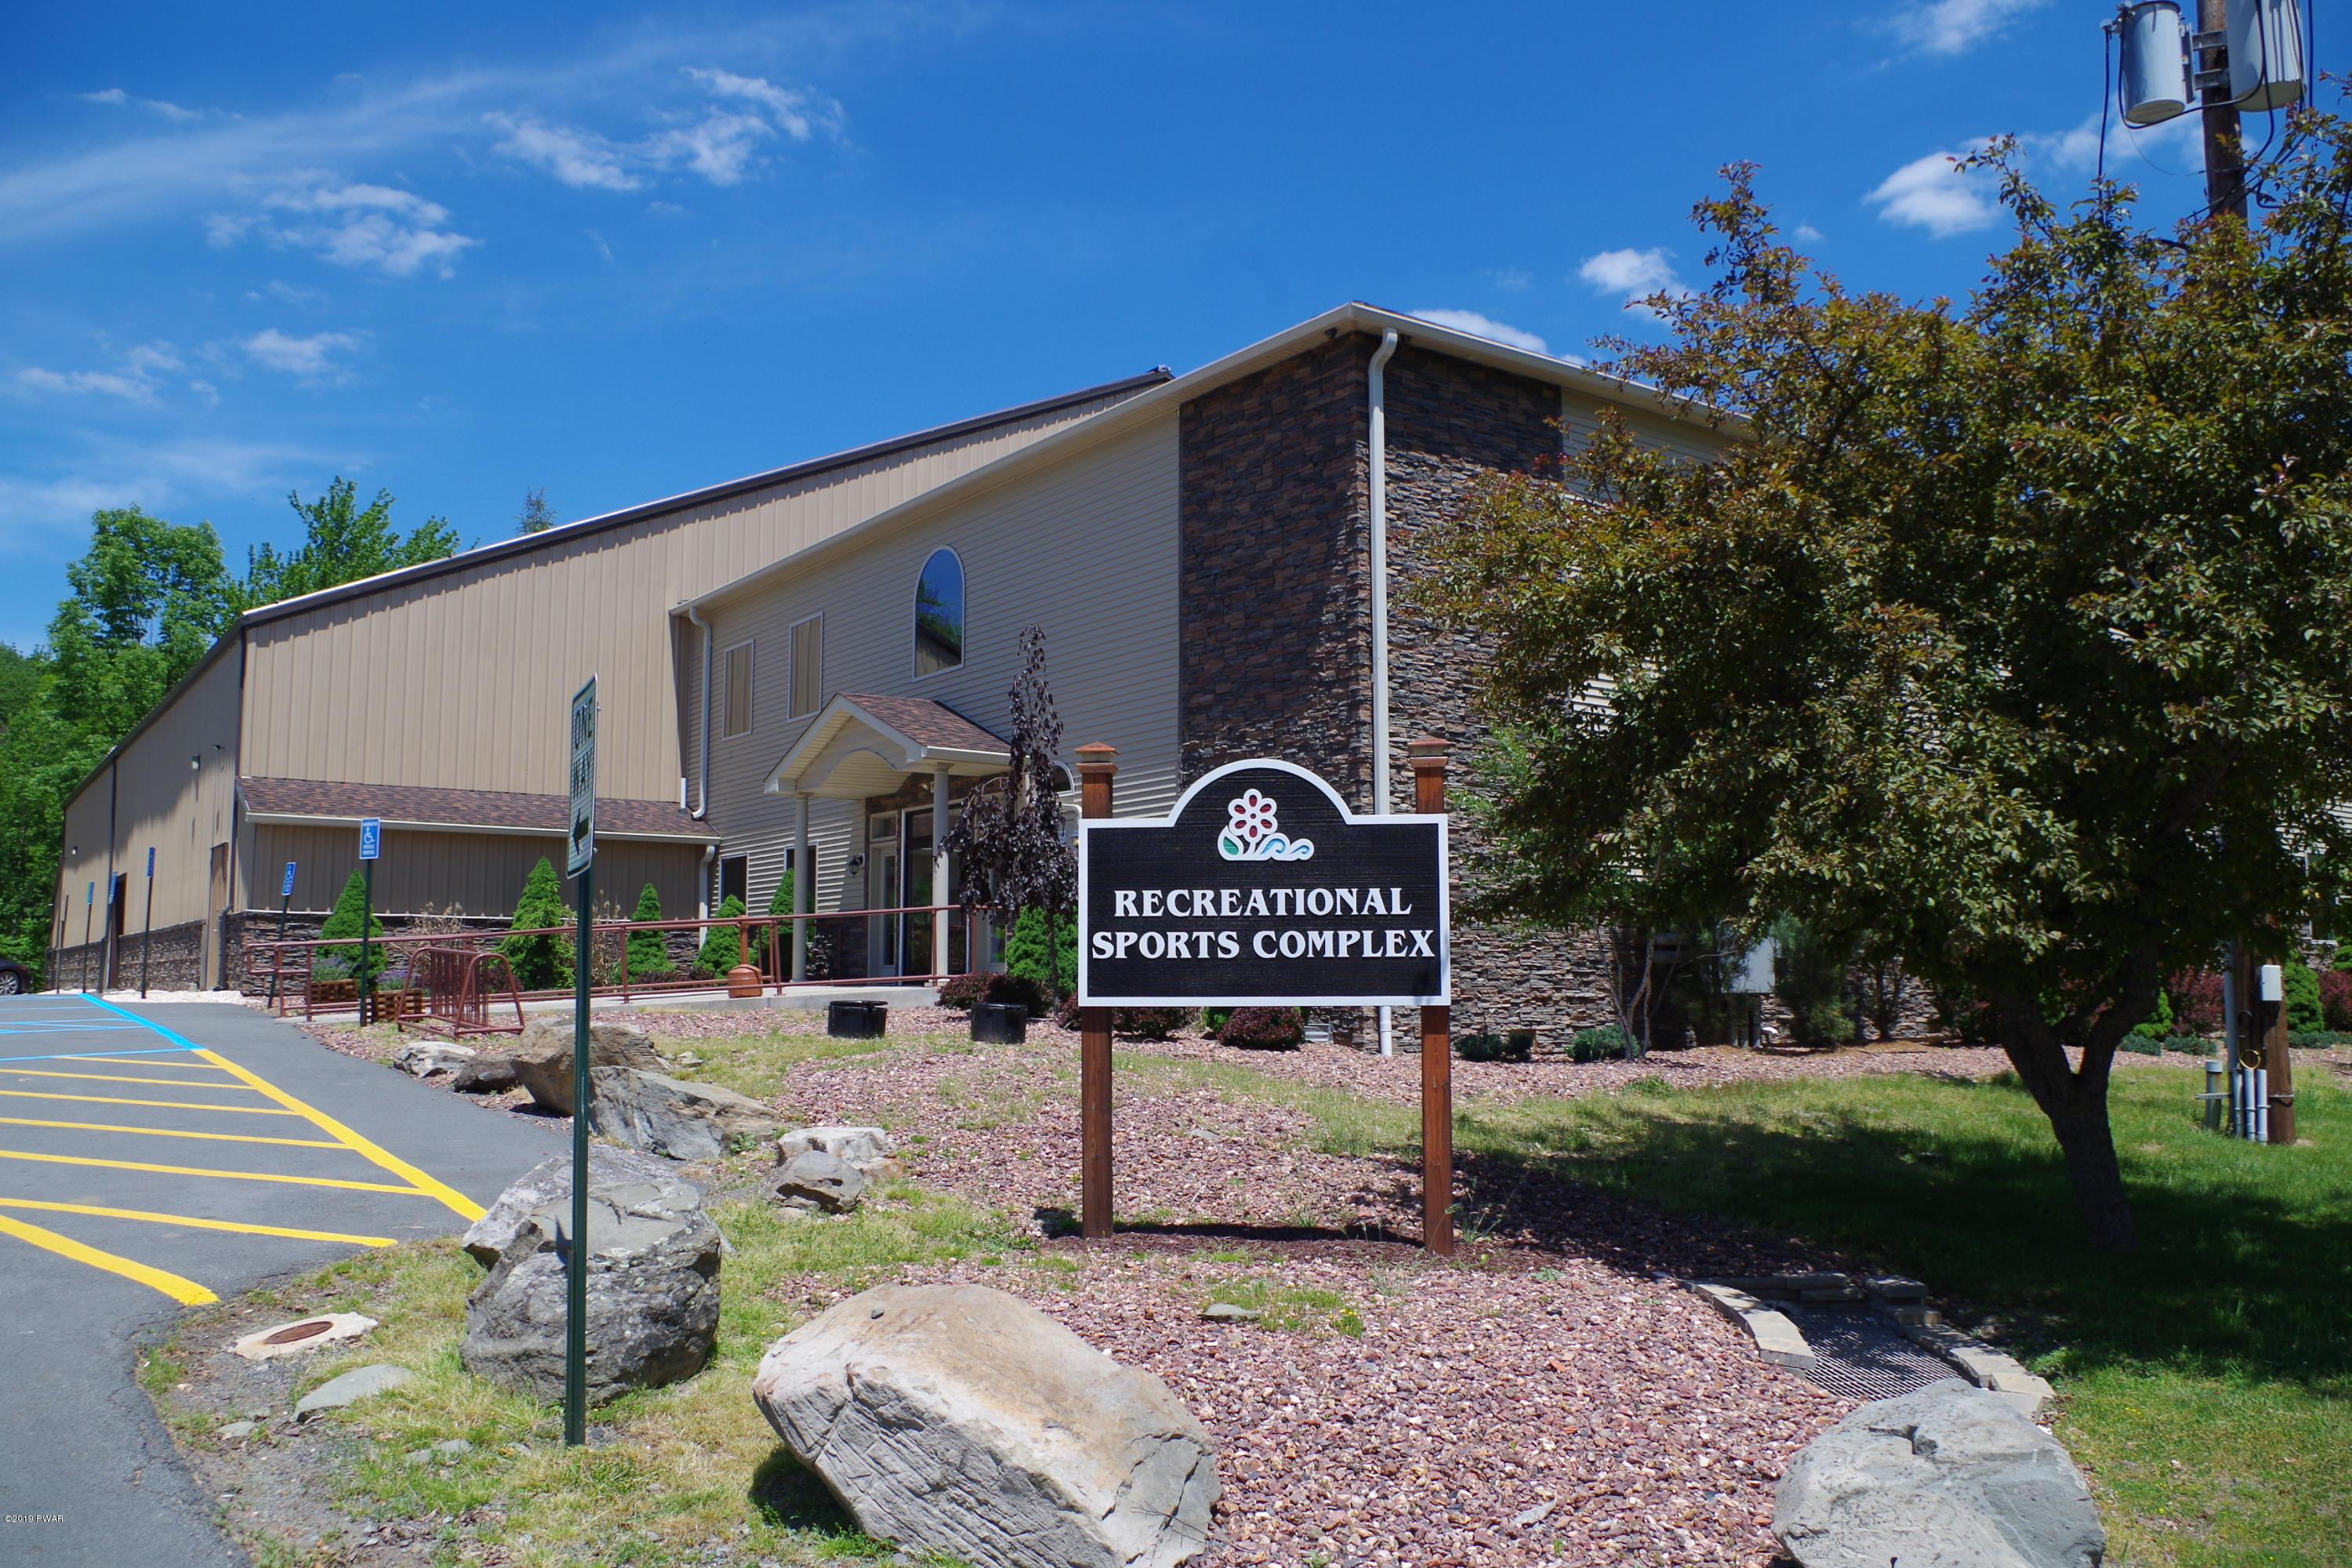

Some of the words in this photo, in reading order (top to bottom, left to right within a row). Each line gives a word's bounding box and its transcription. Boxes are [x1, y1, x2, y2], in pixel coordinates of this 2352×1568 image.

[575, 695, 593, 750] ONE
[572, 746, 593, 800] WAY
[1114, 887, 1412, 917] RECREATIONAL
[1092, 931, 1240, 960] SPORTS
[1253, 930, 1436, 959] COMPLEX
